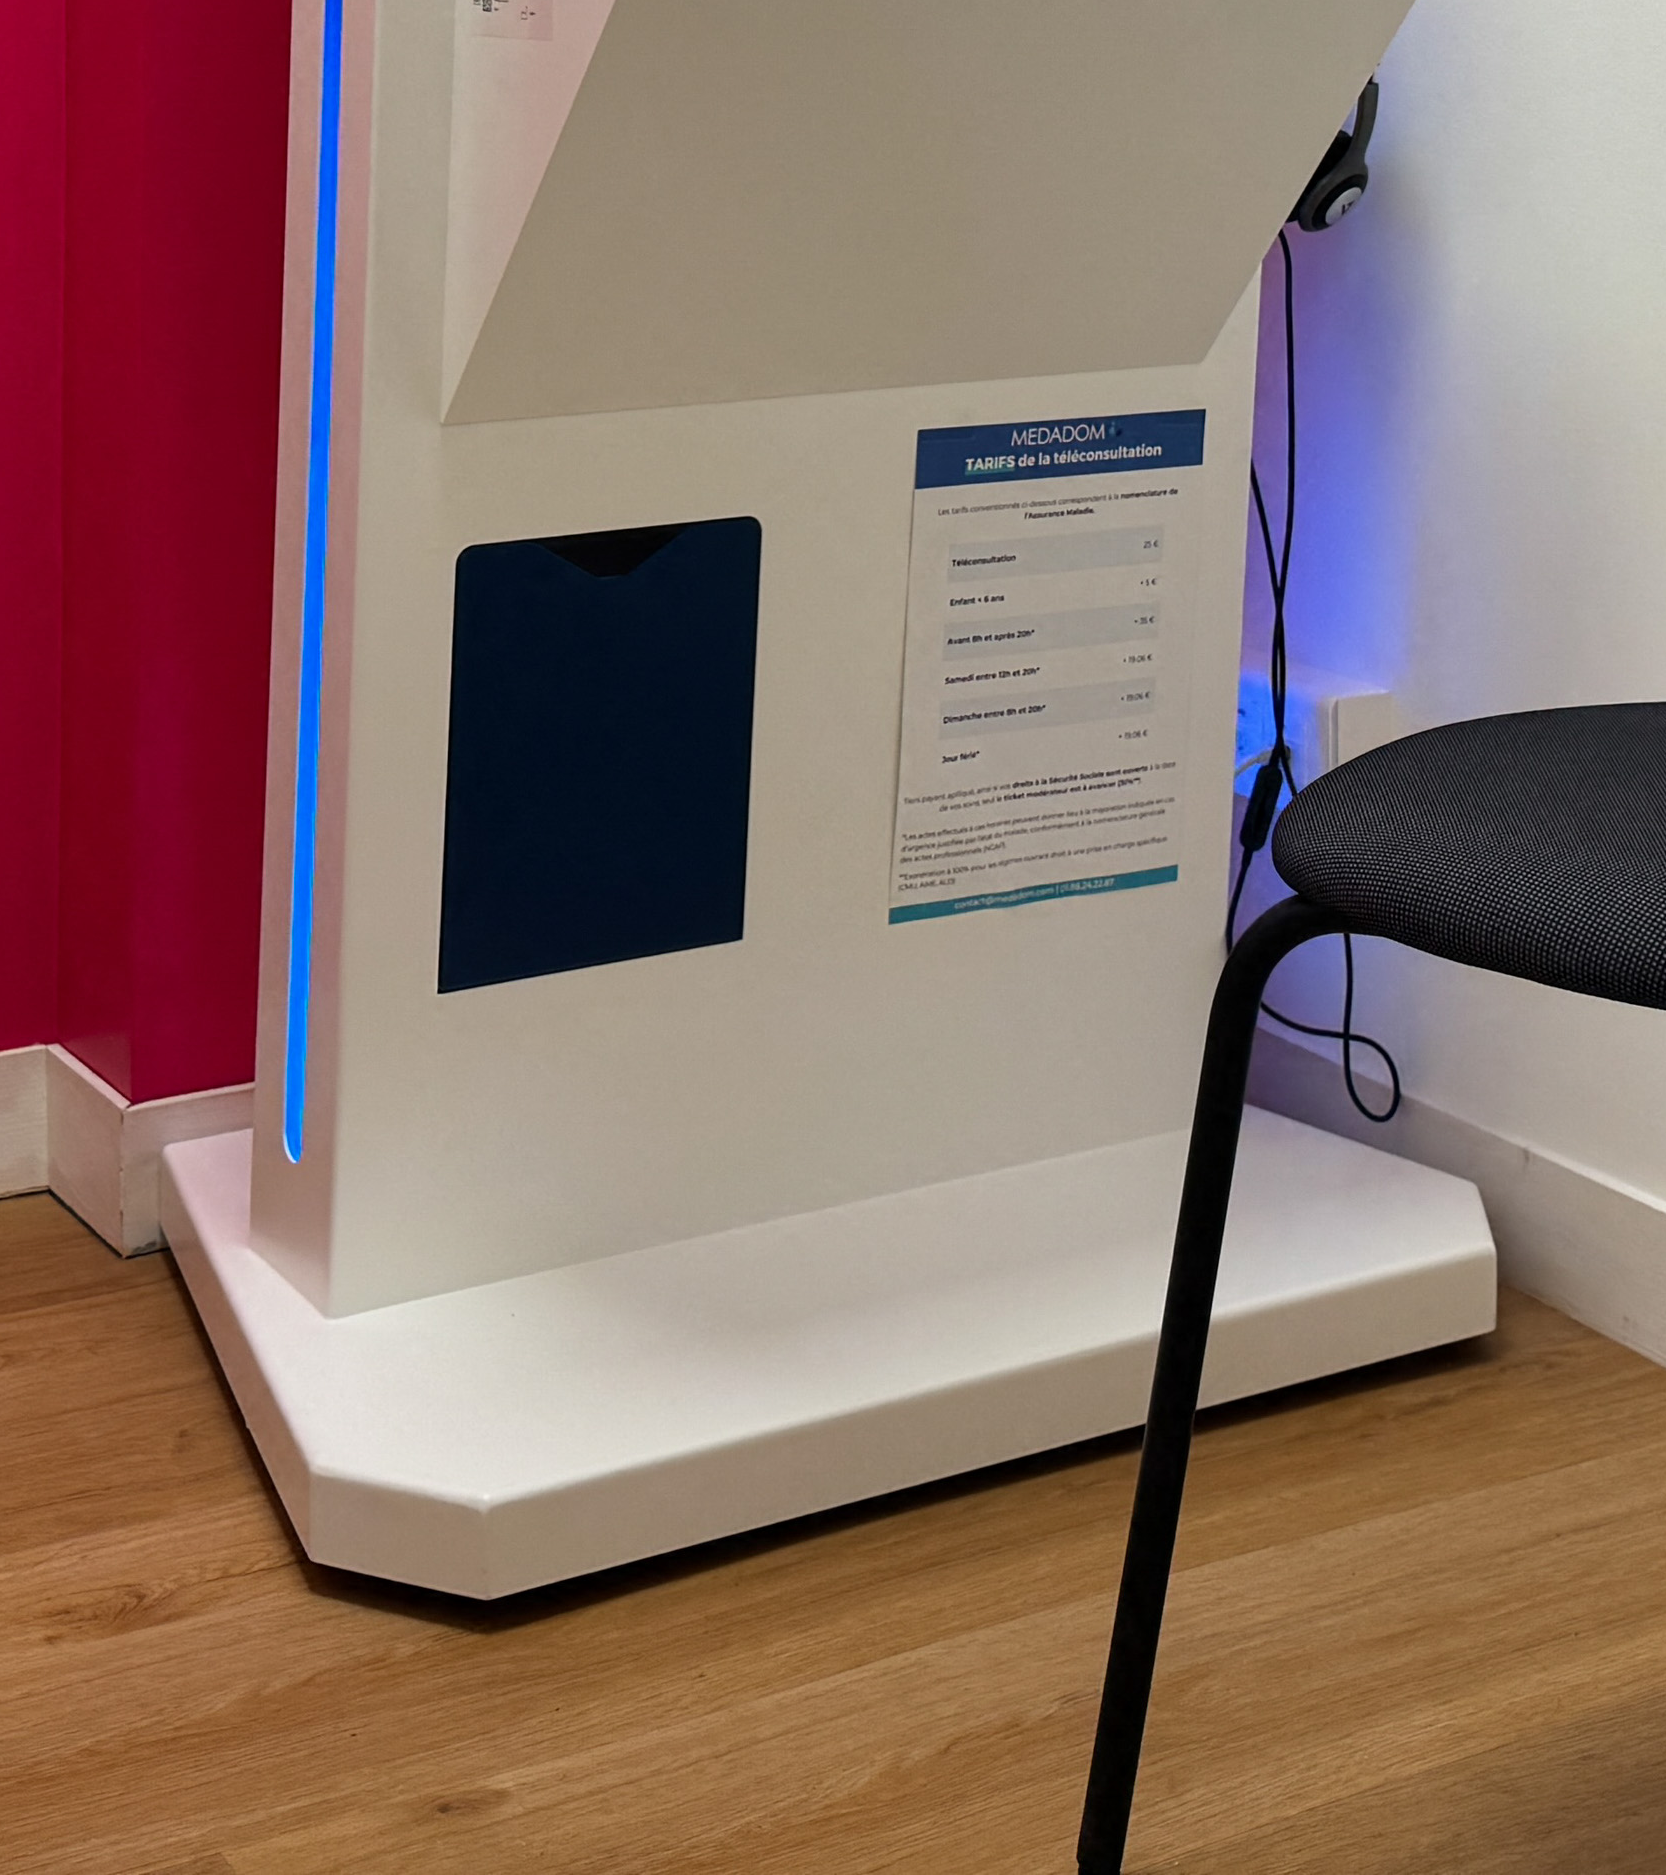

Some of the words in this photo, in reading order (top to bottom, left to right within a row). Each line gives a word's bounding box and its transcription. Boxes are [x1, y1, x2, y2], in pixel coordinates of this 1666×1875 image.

[1011, 424, 1106, 447] MEDADOM
[965, 455, 1016, 472] TARIFS
[1018, 453, 1035, 467] de
[1038, 452, 1051, 466] la
[1053, 443, 1162, 465] téléconsultation
[951, 555, 1017, 567] Téléconsultation
[949, 597, 975, 606] Enfant
[990, 595, 1005, 603] ans
[947, 636, 970, 645] Avant
[984, 634, 992, 642] et
[994, 632, 1015, 641] après
[944, 673, 974, 685] Samedi
[975, 672, 997, 681] entre
[1012, 669, 1020, 677] et
[942, 712, 982, 724] Dimanche
[1018, 707, 1026, 715] et
